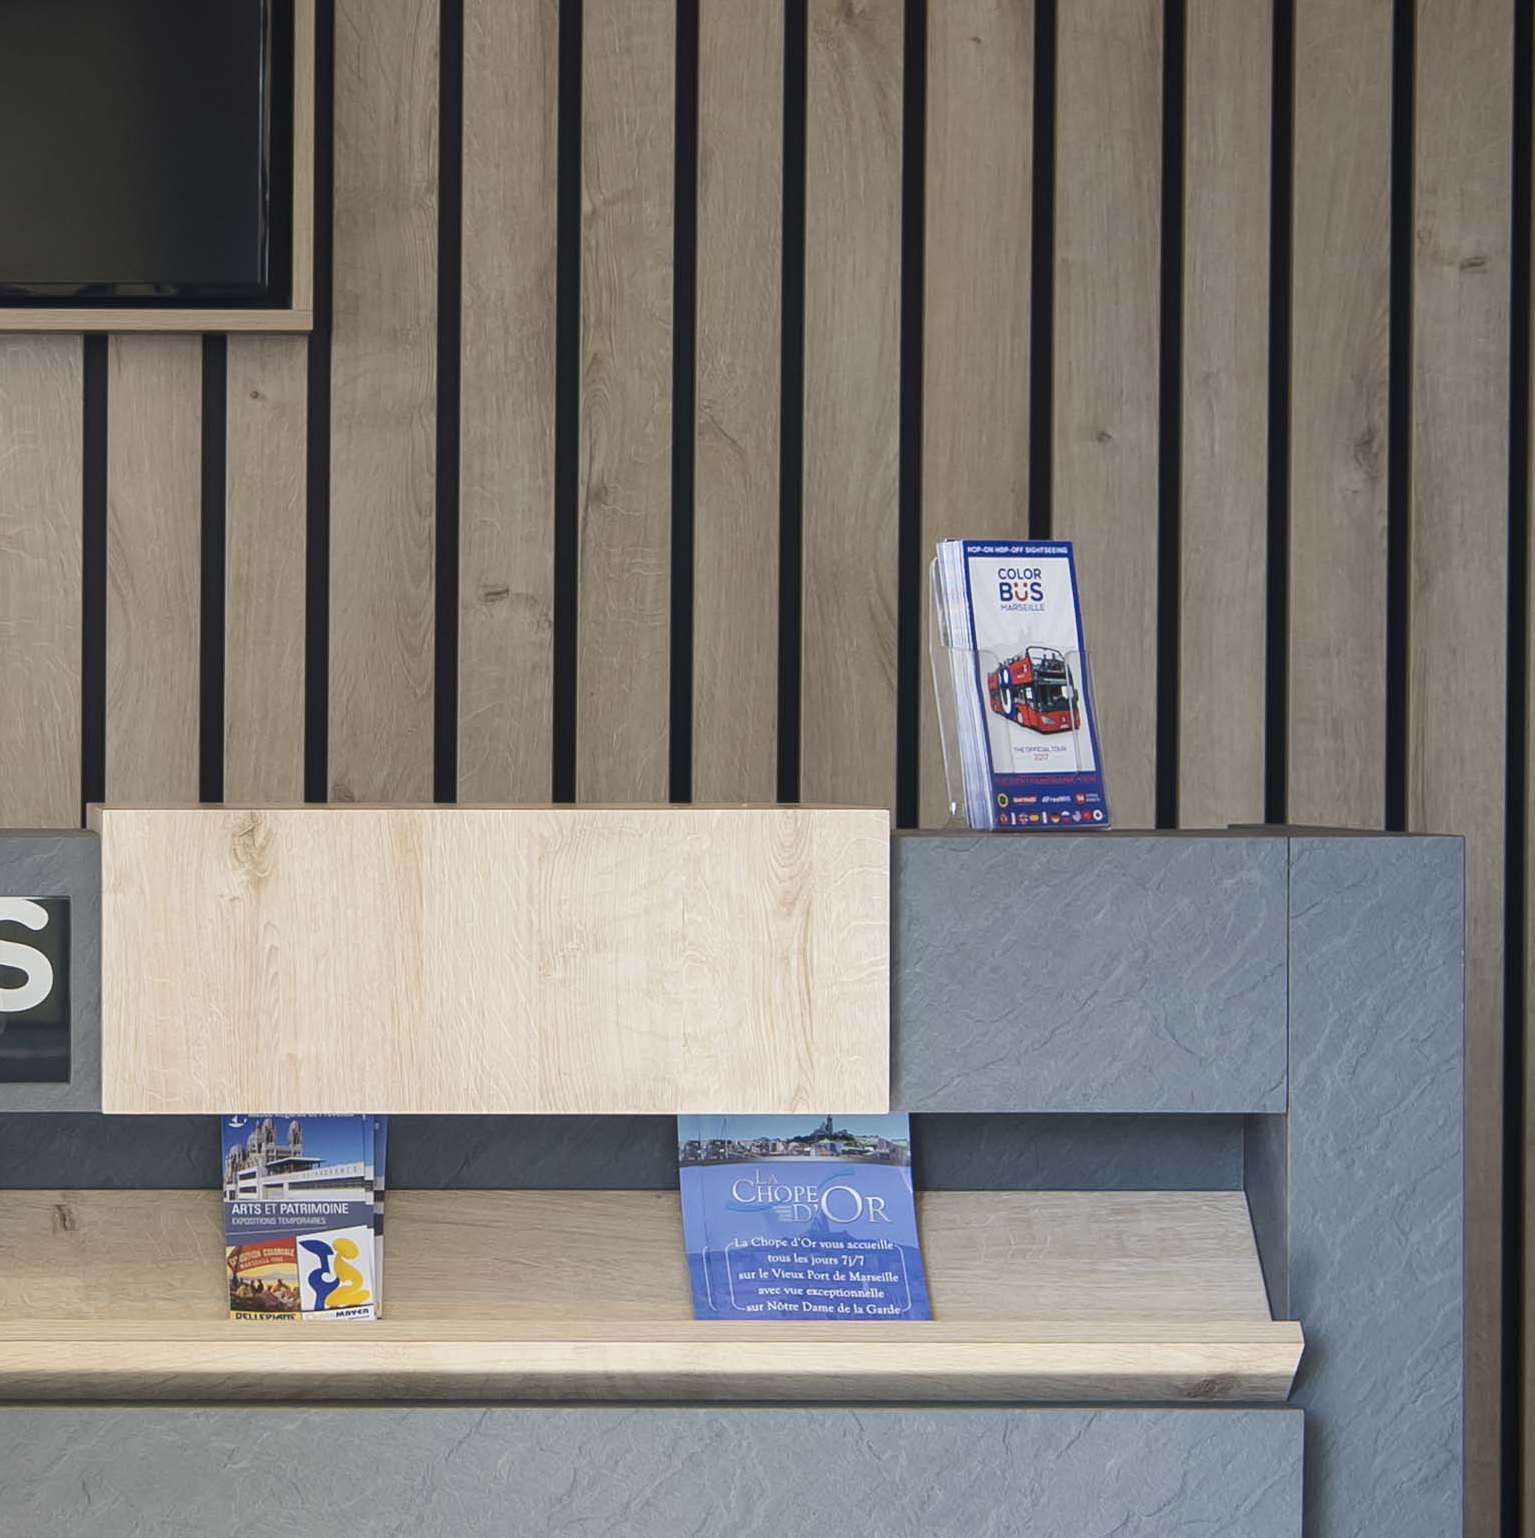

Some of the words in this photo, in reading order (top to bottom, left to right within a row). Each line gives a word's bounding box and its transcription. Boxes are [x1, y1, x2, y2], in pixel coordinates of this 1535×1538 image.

[1025, 546, 1069, 554] SIGHTSEEING
[998, 568, 1042, 580] COLOR
[1000, 603, 1045, 612] MARSEILLE
[231, 1203, 262, 1214] ARTS
[265, 1203, 278, 1214] ET
[280, 1202, 349, 1214] PATRIMOINE
[231, 1217, 276, 1225] EXPOSITIONS
[277, 1216, 327, 1225] TEMPORAIRES
[734, 1237, 749, 1248] La
[751, 1236, 789, 1249] Chope
[791, 1236, 818, 1248] d'Or
[819, 1241, 845, 1249] vous
[847, 1238, 894, 1250] accueille
[767, 1254, 792, 1263] tous
[793, 1252, 809, 1264] les
[811, 1254, 839, 1266] jours
[841, 1254, 865, 1268] 7j/7
[738, 1271, 757, 1280] sur
[758, 1268, 769, 1279] le
[771, 1268, 805, 1279] Vieux
[807, 1269, 831, 1281] Port
[832, 1270, 846, 1281] de
[849, 1271, 900, 1283] Marseille
[758, 1287, 782, 1295] avec
[783, 1287, 804, 1295] vue
[806, 1287, 886, 1299] exceptionnelle
[745, 1304, 764, 1312] sur
[766, 1300, 800, 1312] Nôtre
[802, 1301, 835, 1313] Dame
[837, 1303, 851, 1314] de
[853, 1303, 865, 1314] la
[866, 1303, 901, 1315] Garde
